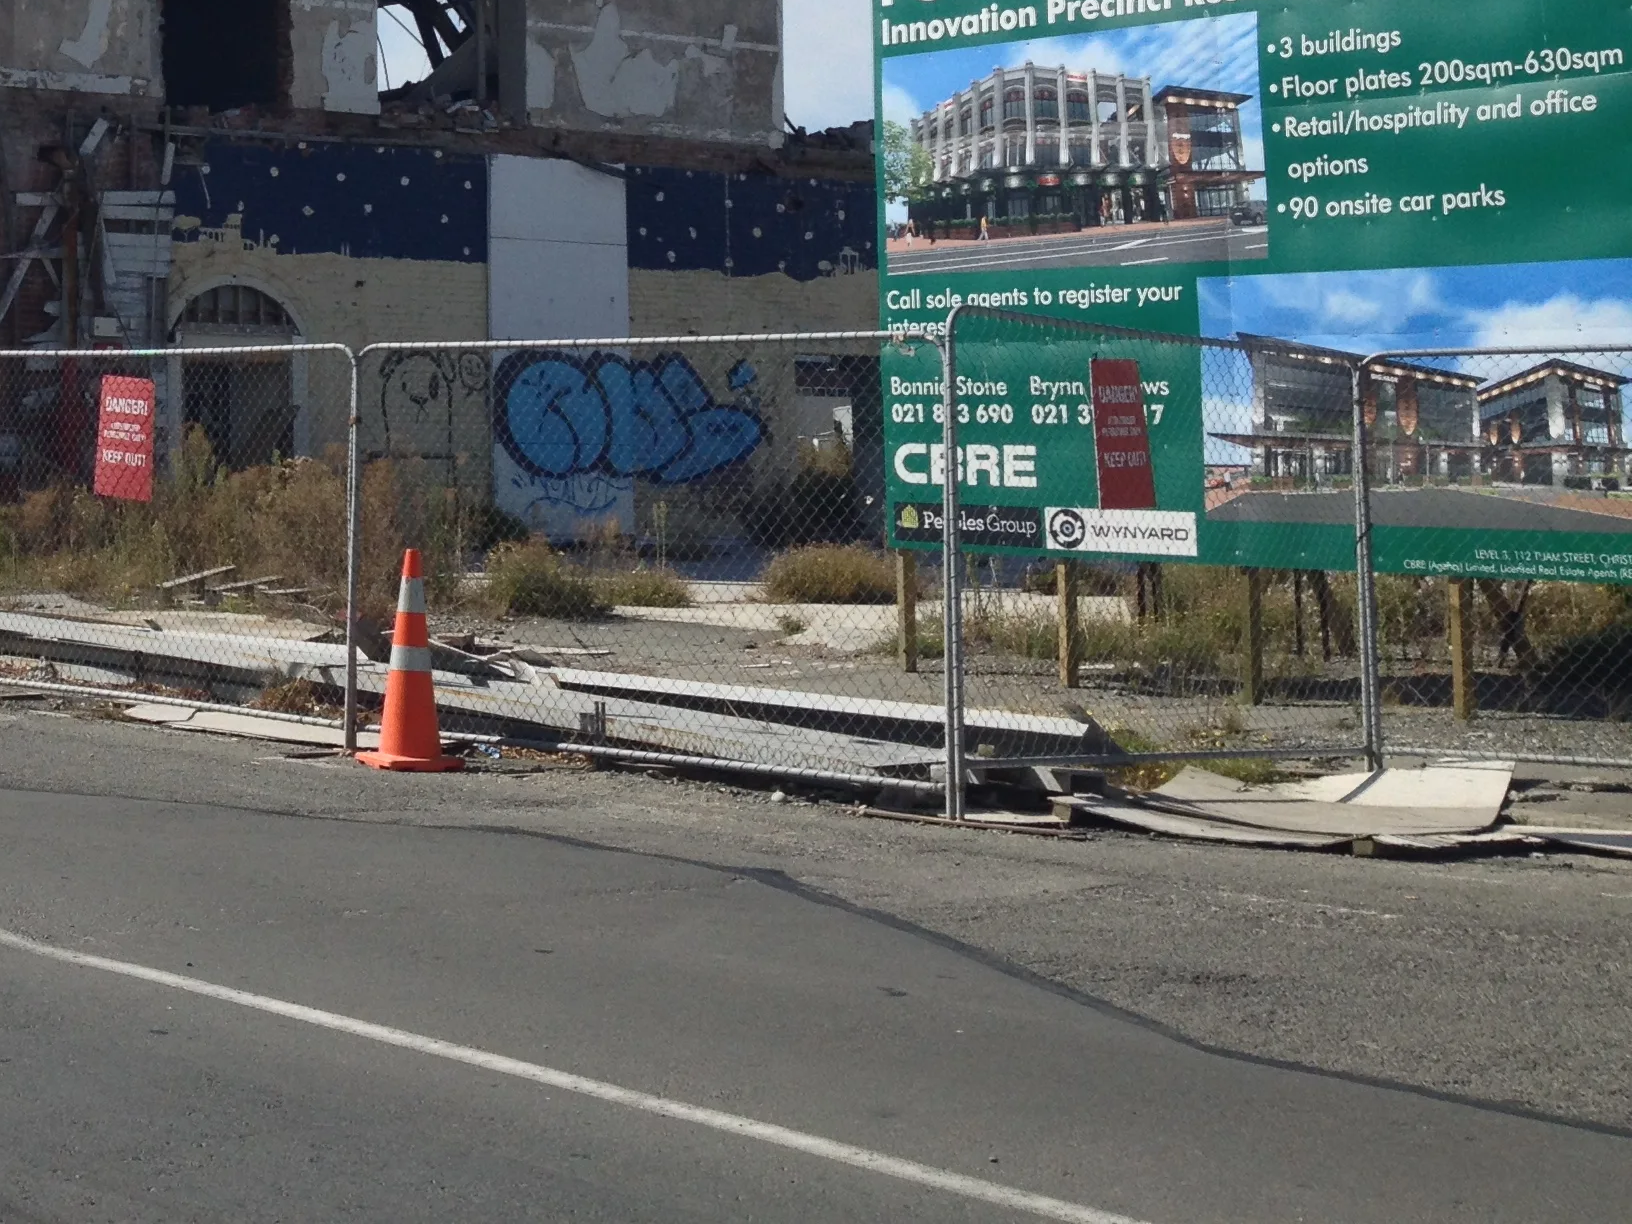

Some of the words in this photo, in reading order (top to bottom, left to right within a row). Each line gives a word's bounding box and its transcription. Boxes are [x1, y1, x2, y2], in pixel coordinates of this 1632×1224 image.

[881, 3, 1037, 46] Innovation
[1279, 37, 1293, 59] 3
[1301, 27, 1402, 56] buildings
[1282, 75, 1338, 98] Floor
[1345, 69, 1412, 97] plates
[1418, 46, 1624, 86] 200sqm-630sqm
[1284, 101, 1470, 138] Retail/hospitality
[1476, 93, 1521, 122] and
[1530, 89, 1598, 116] office
[1287, 154, 1369, 183] options
[1289, 196, 1319, 219] 90
[1326, 192, 1393, 218] onsite
[1399, 194, 1435, 214] car
[1442, 182, 1506, 215] parks
[886, 288, 921, 310] Call
[926, 287, 962, 308] sole
[968, 287, 1028, 308] agents
[1033, 288, 1053, 306] to
[1058, 283, 1132, 308] register
[1136, 285, 1183, 309] your
[956, 376, 1008, 396] Stone
[1030, 376, 1084, 402] Brynn
[105, 396, 148, 416] DANGER!
[892, 403, 924, 423] 021
[933, 403, 970, 424] 83
[976, 403, 1014, 424] 690
[1032, 404, 1068, 425] 021
[102, 449, 124, 464] KEEP
[894, 443, 1037, 487] CBRE
[923, 511, 984, 531] Peles
[986, 513, 1037, 538] Group
[1092, 524, 1189, 542] WYNYARD
[1475, 550, 1499, 560] LEVEL
[1538, 565, 1557, 575] Real
[1559, 566, 1585, 577] Estate
